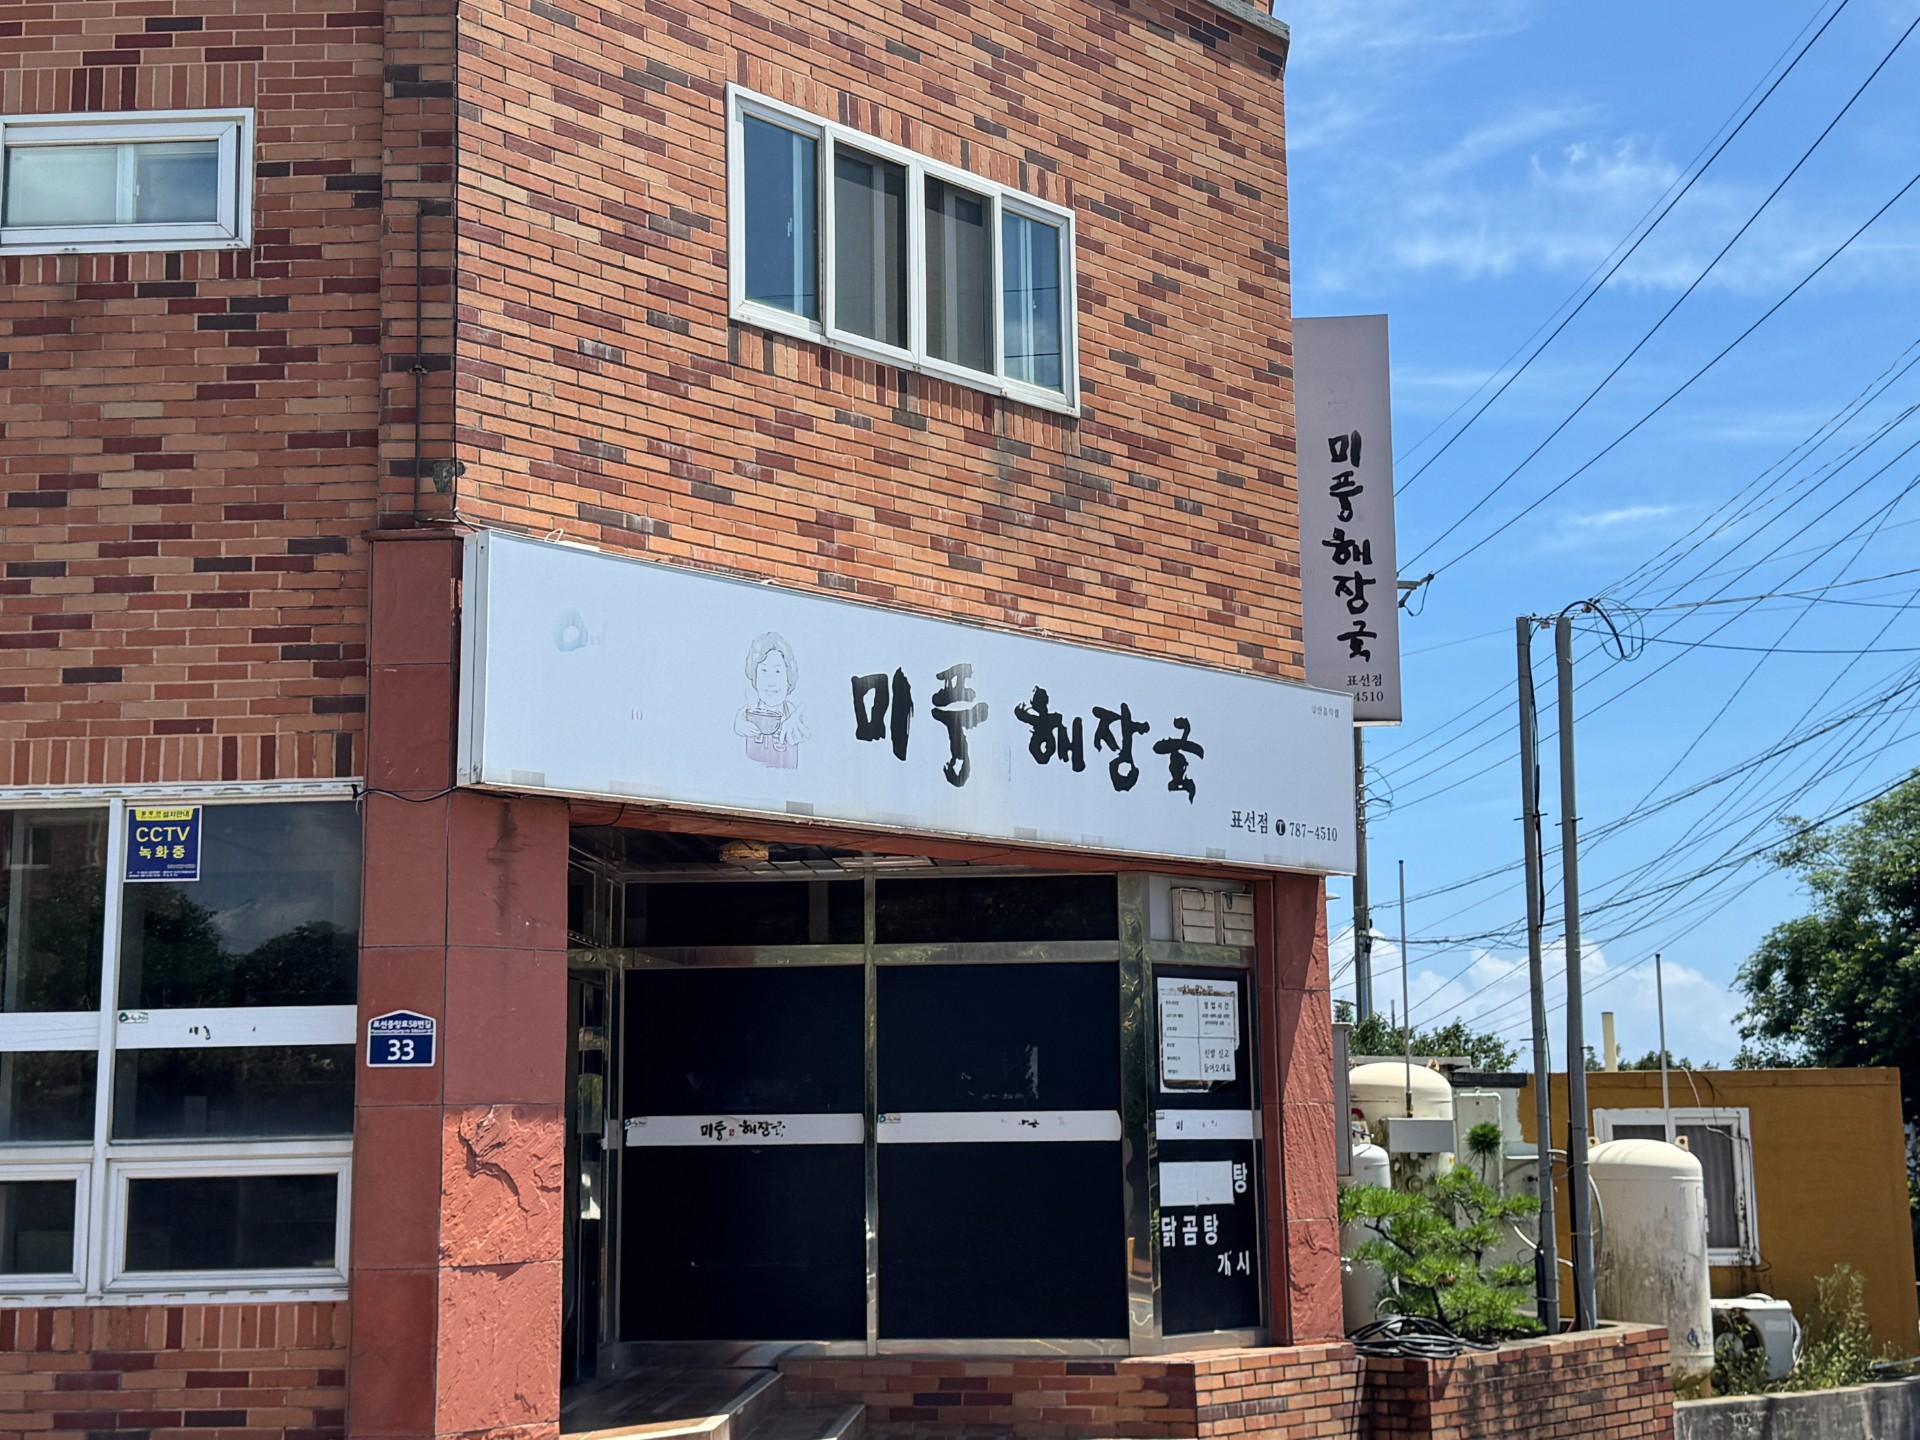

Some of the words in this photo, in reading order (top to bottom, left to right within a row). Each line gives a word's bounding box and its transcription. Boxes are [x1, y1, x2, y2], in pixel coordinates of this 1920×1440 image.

[1346, 673, 1382, 687] 표선점
[851, 663, 989, 787] 미풍
[1013, 685, 1205, 804] 해장국
[135, 826, 191, 843] CCTV
[1230, 810, 1268, 834] 표선점
[1289, 823, 1338, 842] 787-4510
[387, 1039, 414, 1061] 33
